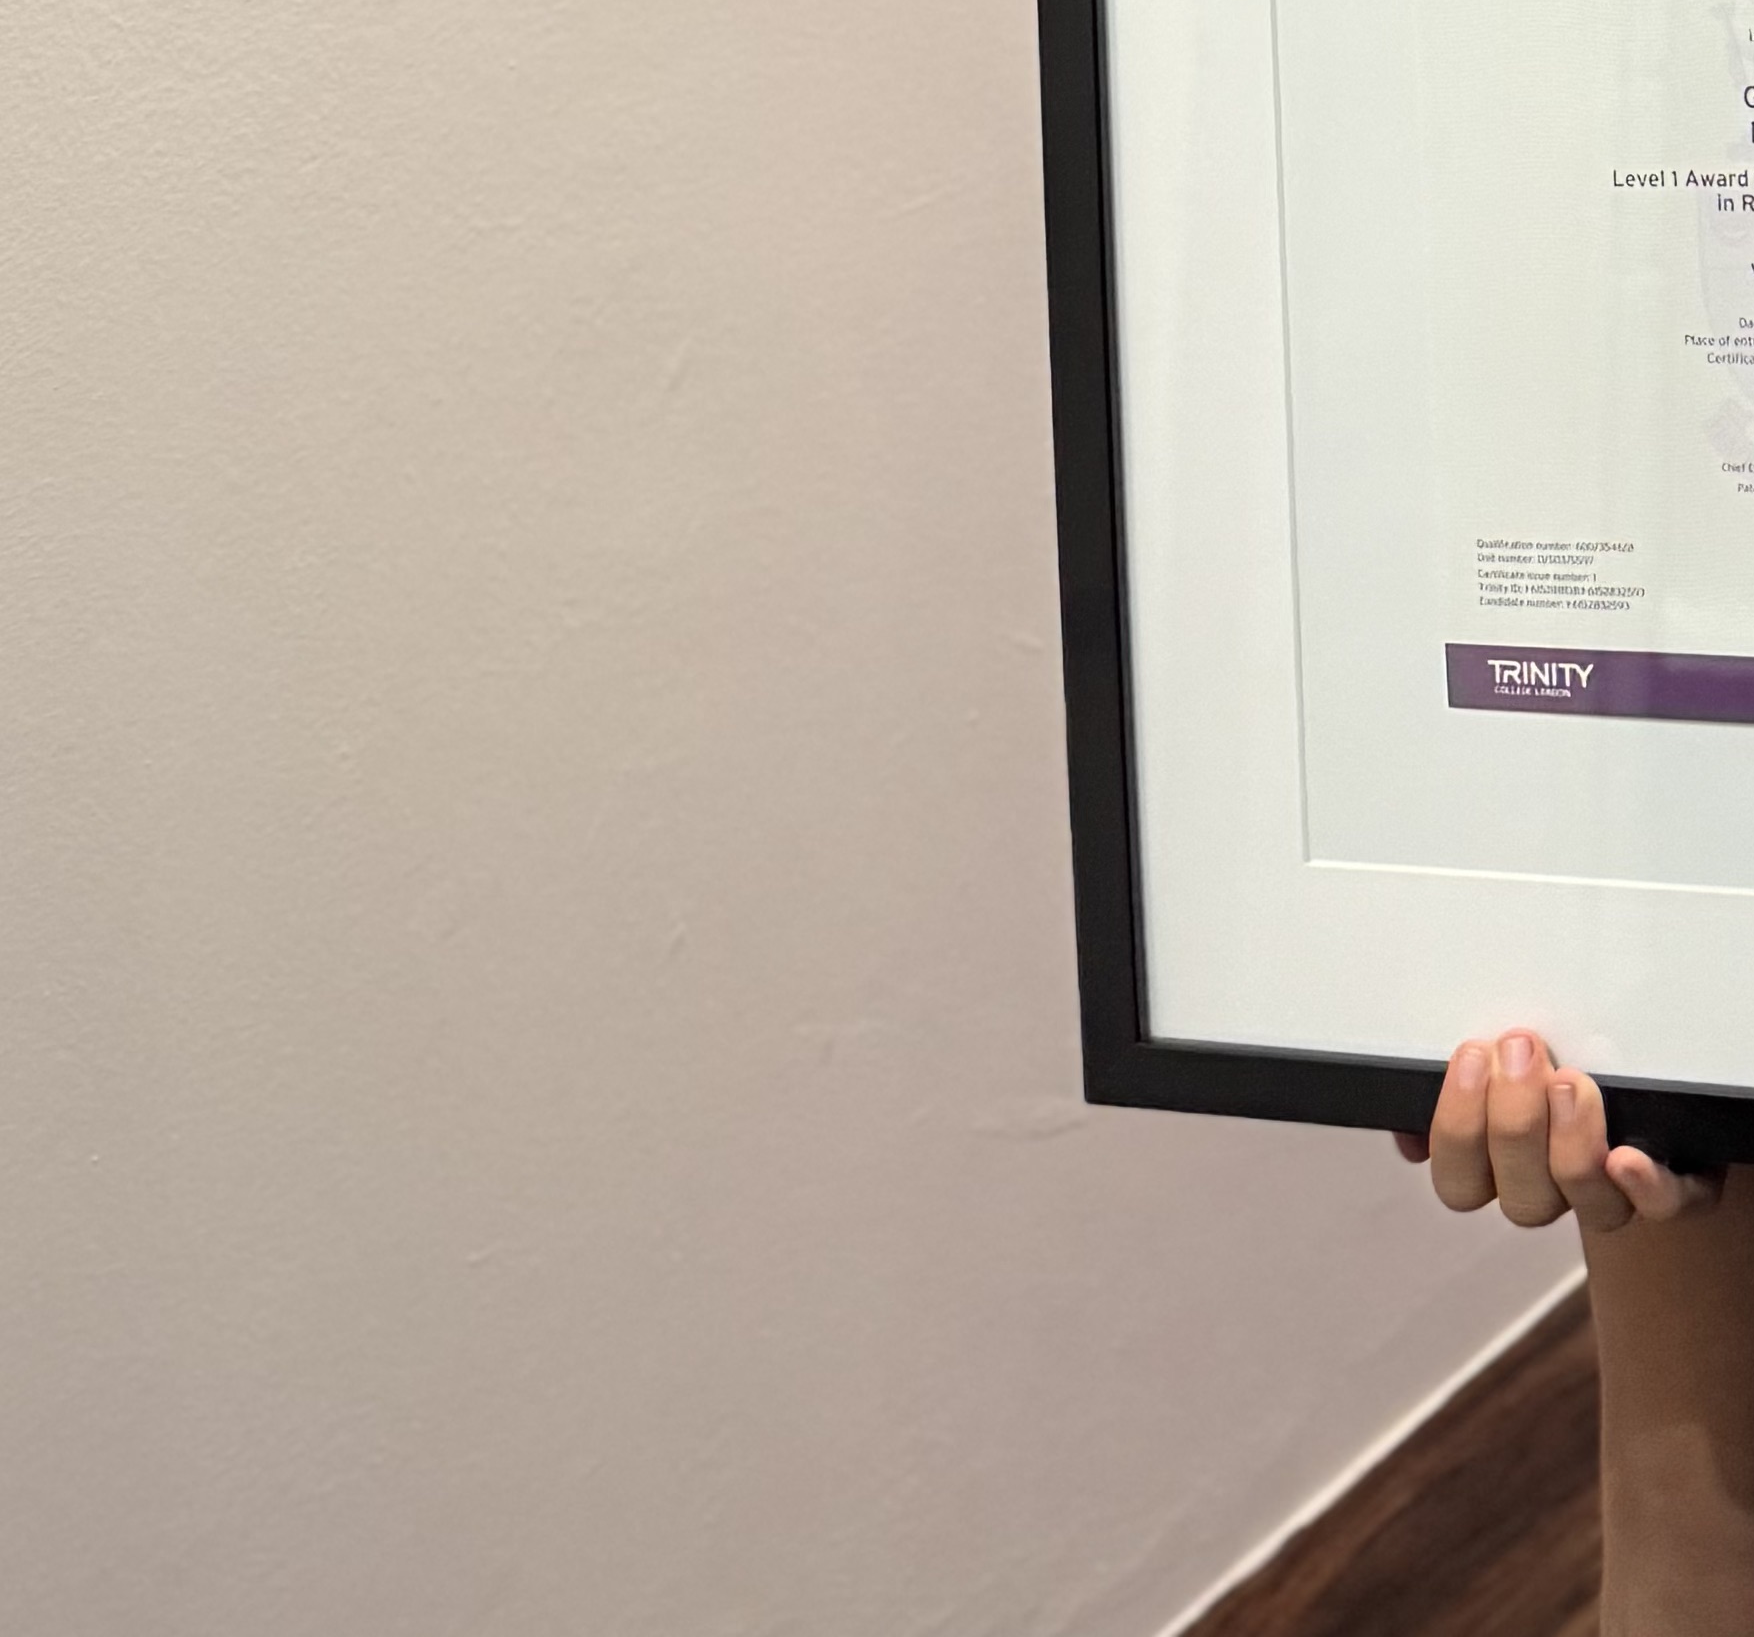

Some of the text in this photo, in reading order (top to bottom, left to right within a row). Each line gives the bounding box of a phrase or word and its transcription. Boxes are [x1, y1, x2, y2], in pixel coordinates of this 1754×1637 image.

[1613, 170, 1665, 187] Level
[1672, 171, 1678, 186] 1
[1686, 170, 1749, 187] Award
[1717, 194, 1735, 212] in
[1685, 334, 1715, 346] Place
[1719, 335, 1730, 346] of
[1487, 659, 1594, 688] TRINITY
